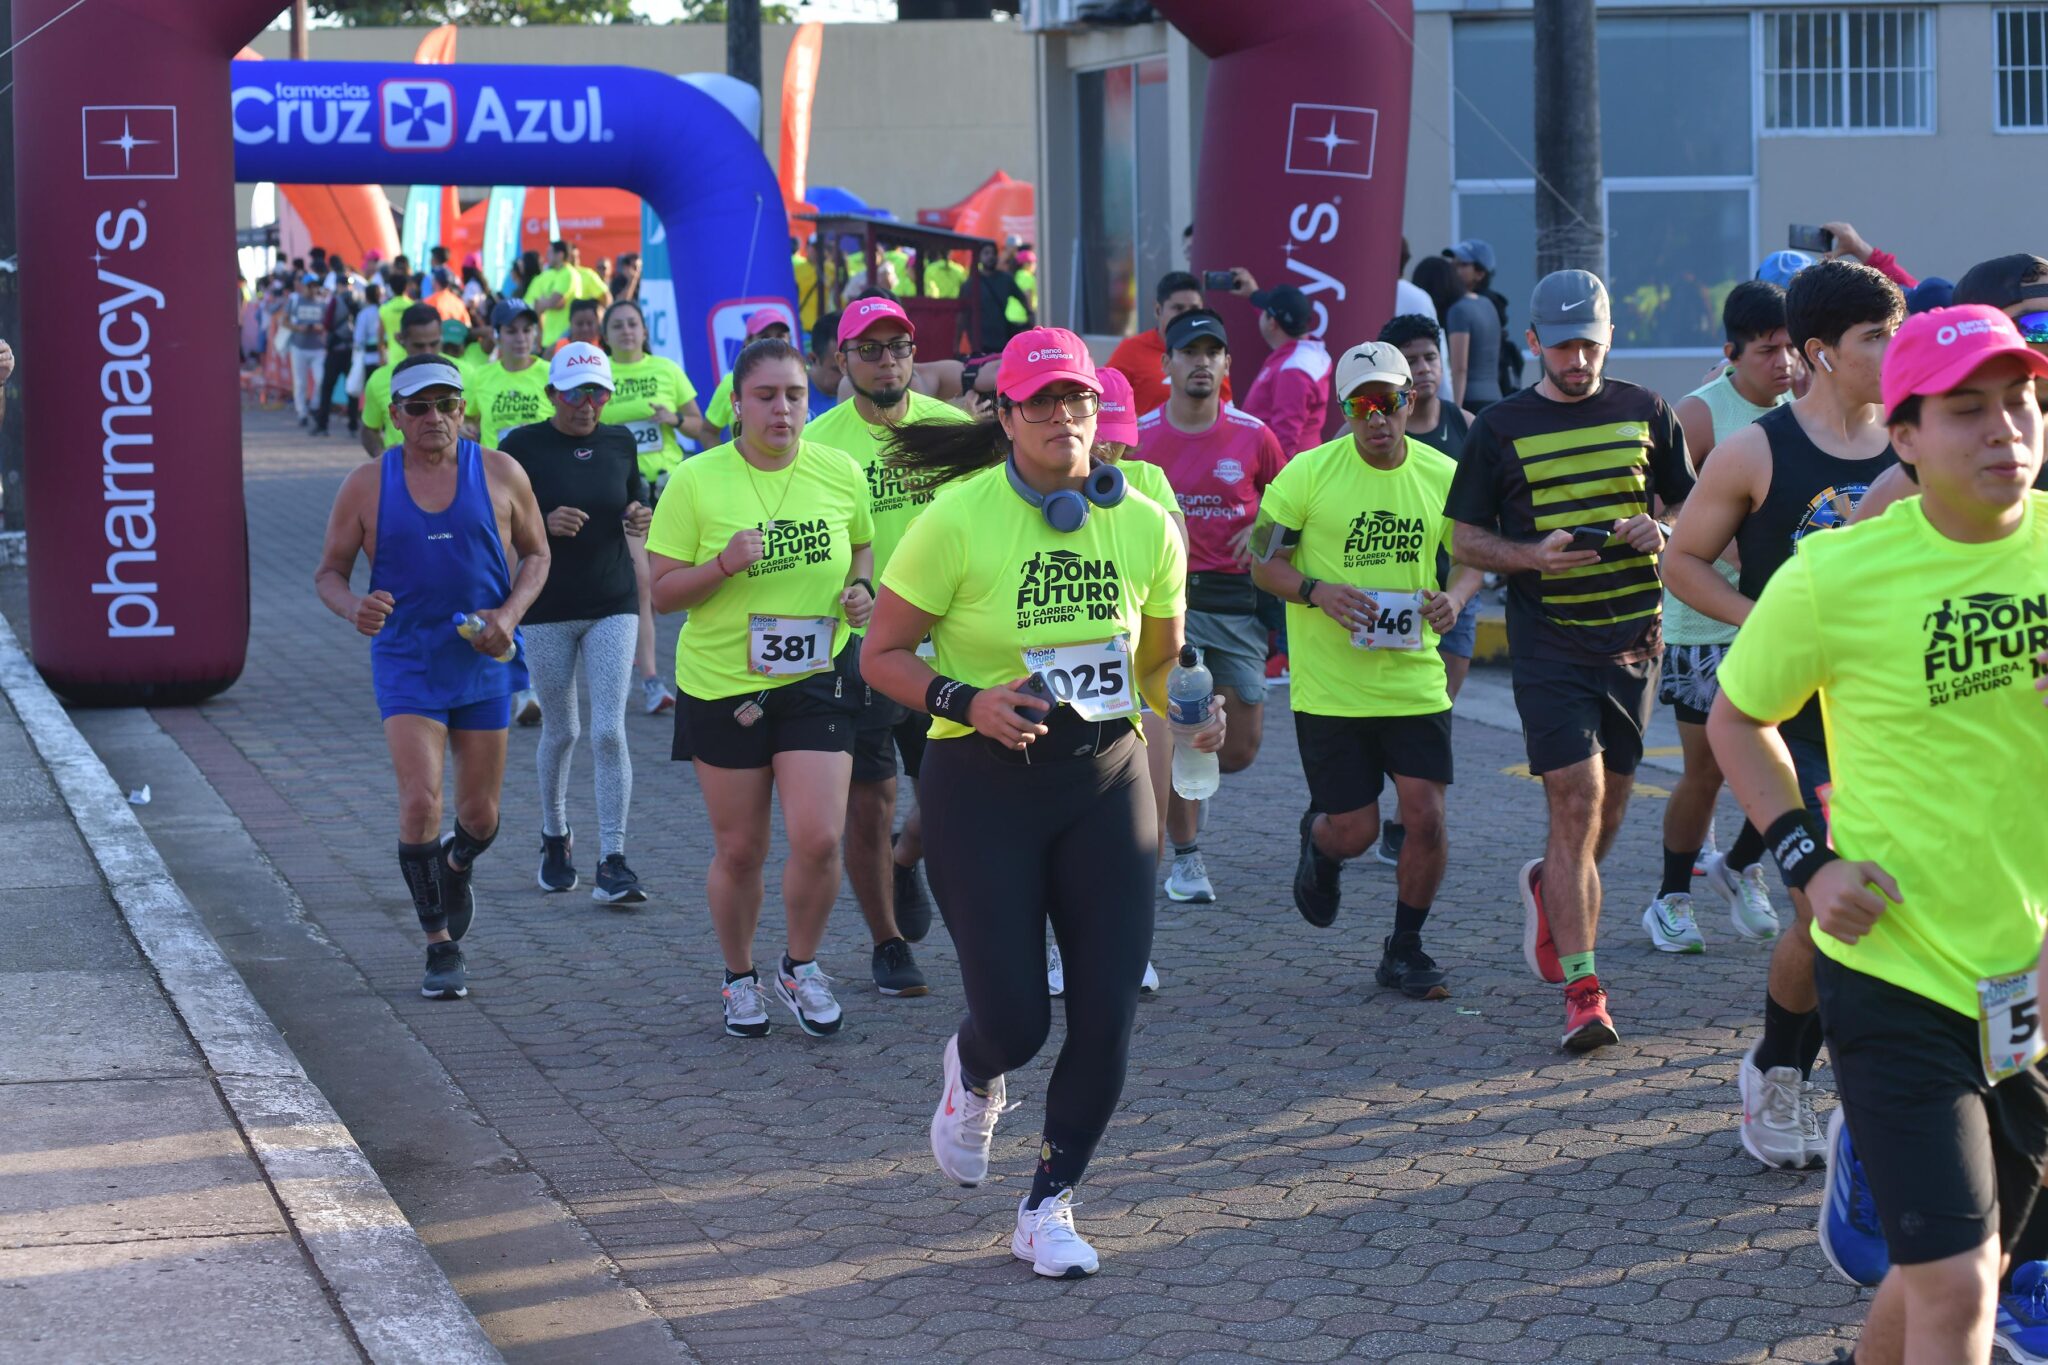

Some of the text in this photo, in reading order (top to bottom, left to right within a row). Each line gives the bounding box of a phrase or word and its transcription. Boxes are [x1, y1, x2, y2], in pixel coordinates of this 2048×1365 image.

[274, 82, 370, 99] farmacias
[231, 86, 604, 144] Cruz Azul
[566, 355, 602, 368] AMS
[90, 207, 175, 638] pharmacy's
[767, 518, 830, 543] DONA
[1365, 518, 1425, 536] DONA
[762, 532, 831, 560] UTURO
[1344, 532, 1423, 554] FUTURO
[760, 554, 803, 569] CARRERA,
[804, 548, 832, 565] 10K
[1355, 552, 1394, 561] CARRERA,
[1355, 558, 1387, 567] FUTURO
[1395, 550, 1420, 563] 10K
[747, 562, 796, 578] SU FUTURO
[1044, 560, 1119, 583] DONA
[1016, 580, 1120, 610] FUTURO
[1017, 604, 1084, 620] TU CARRERA,
[1086, 603, 1121, 620] 10K
[1017, 613, 1076, 629] SU FUTURO
[761, 633, 816, 662] 381
[1928, 661, 2025, 695] TU CARRERA,
[1929, 675, 2013, 707] SU FUTURO
